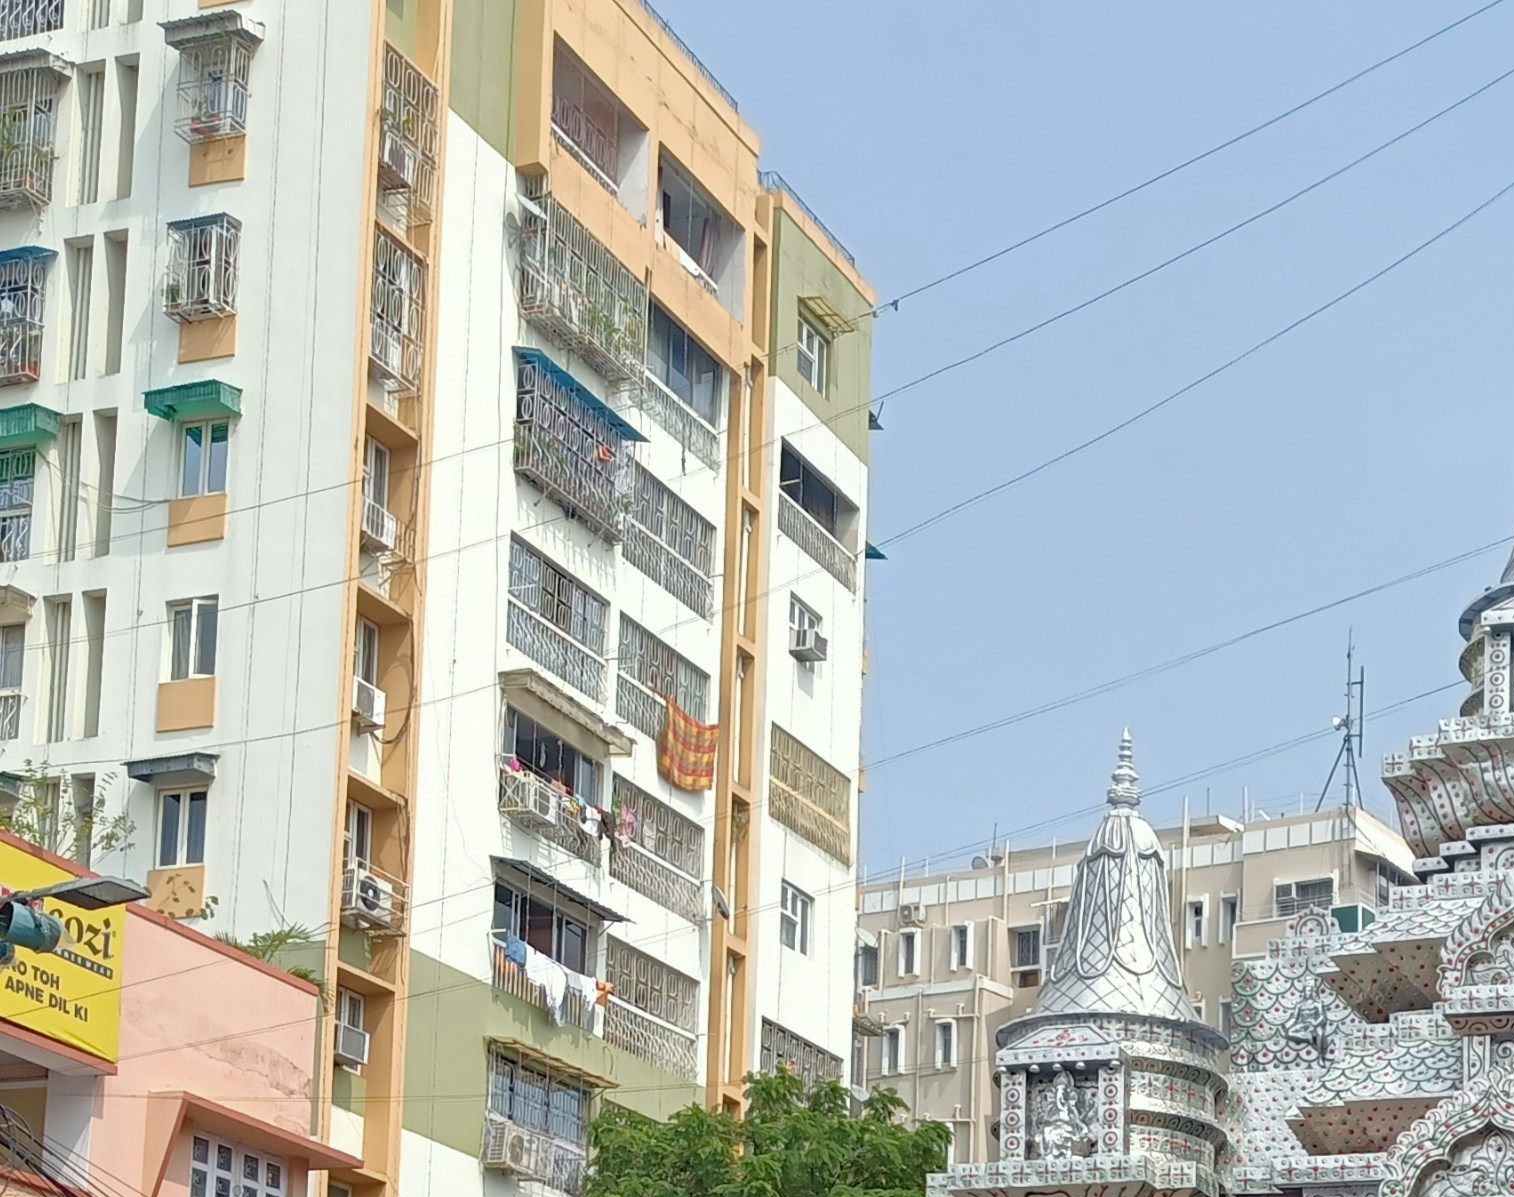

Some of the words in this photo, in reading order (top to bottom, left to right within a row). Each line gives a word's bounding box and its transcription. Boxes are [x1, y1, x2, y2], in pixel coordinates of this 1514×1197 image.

[31, 965, 60, 991] TOH
[5, 976, 45, 1004] APNE
[49, 993, 71, 1014] DIL
[74, 1004, 89, 1023] KI
